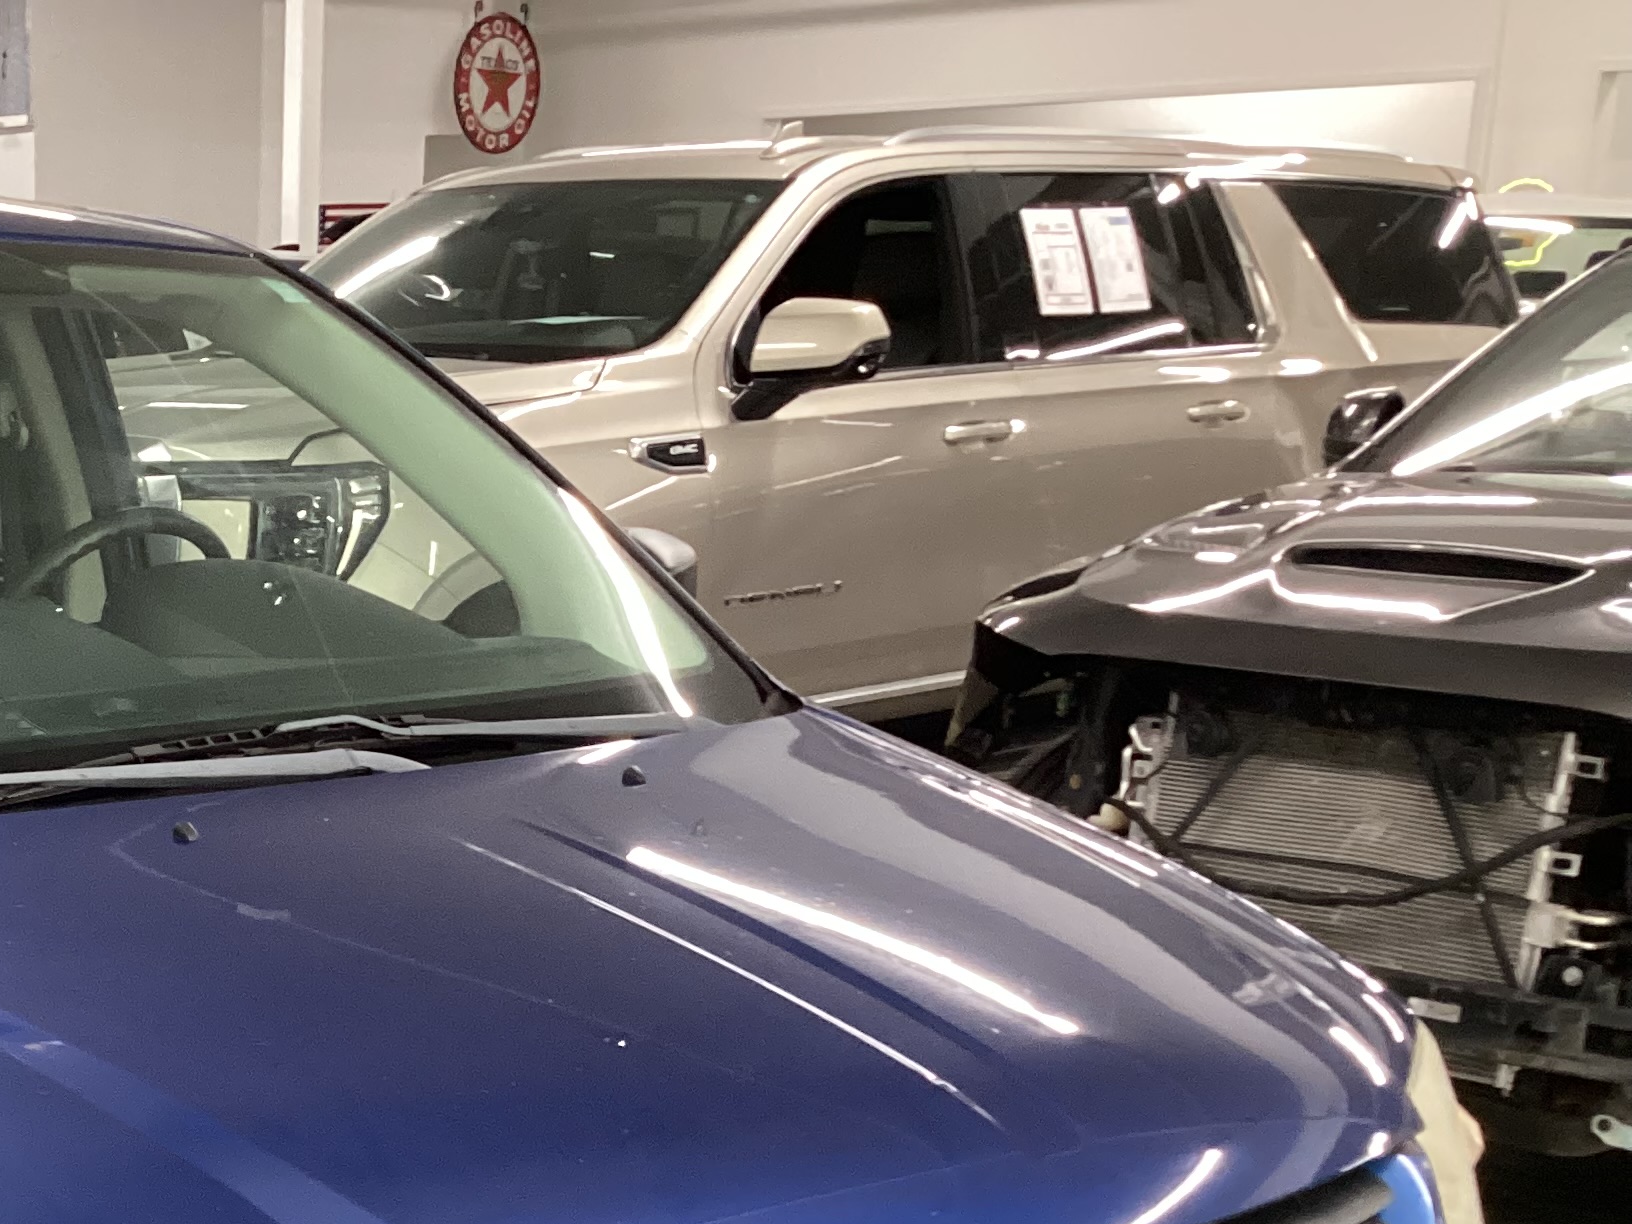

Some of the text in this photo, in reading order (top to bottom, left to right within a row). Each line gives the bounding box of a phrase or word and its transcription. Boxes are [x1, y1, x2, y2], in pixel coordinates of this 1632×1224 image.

[461, 20, 536, 71] GASOLINE
[480, 56, 519, 70] TECO
[458, 92, 510, 150] MOTOR
[514, 99, 535, 135] OIL
